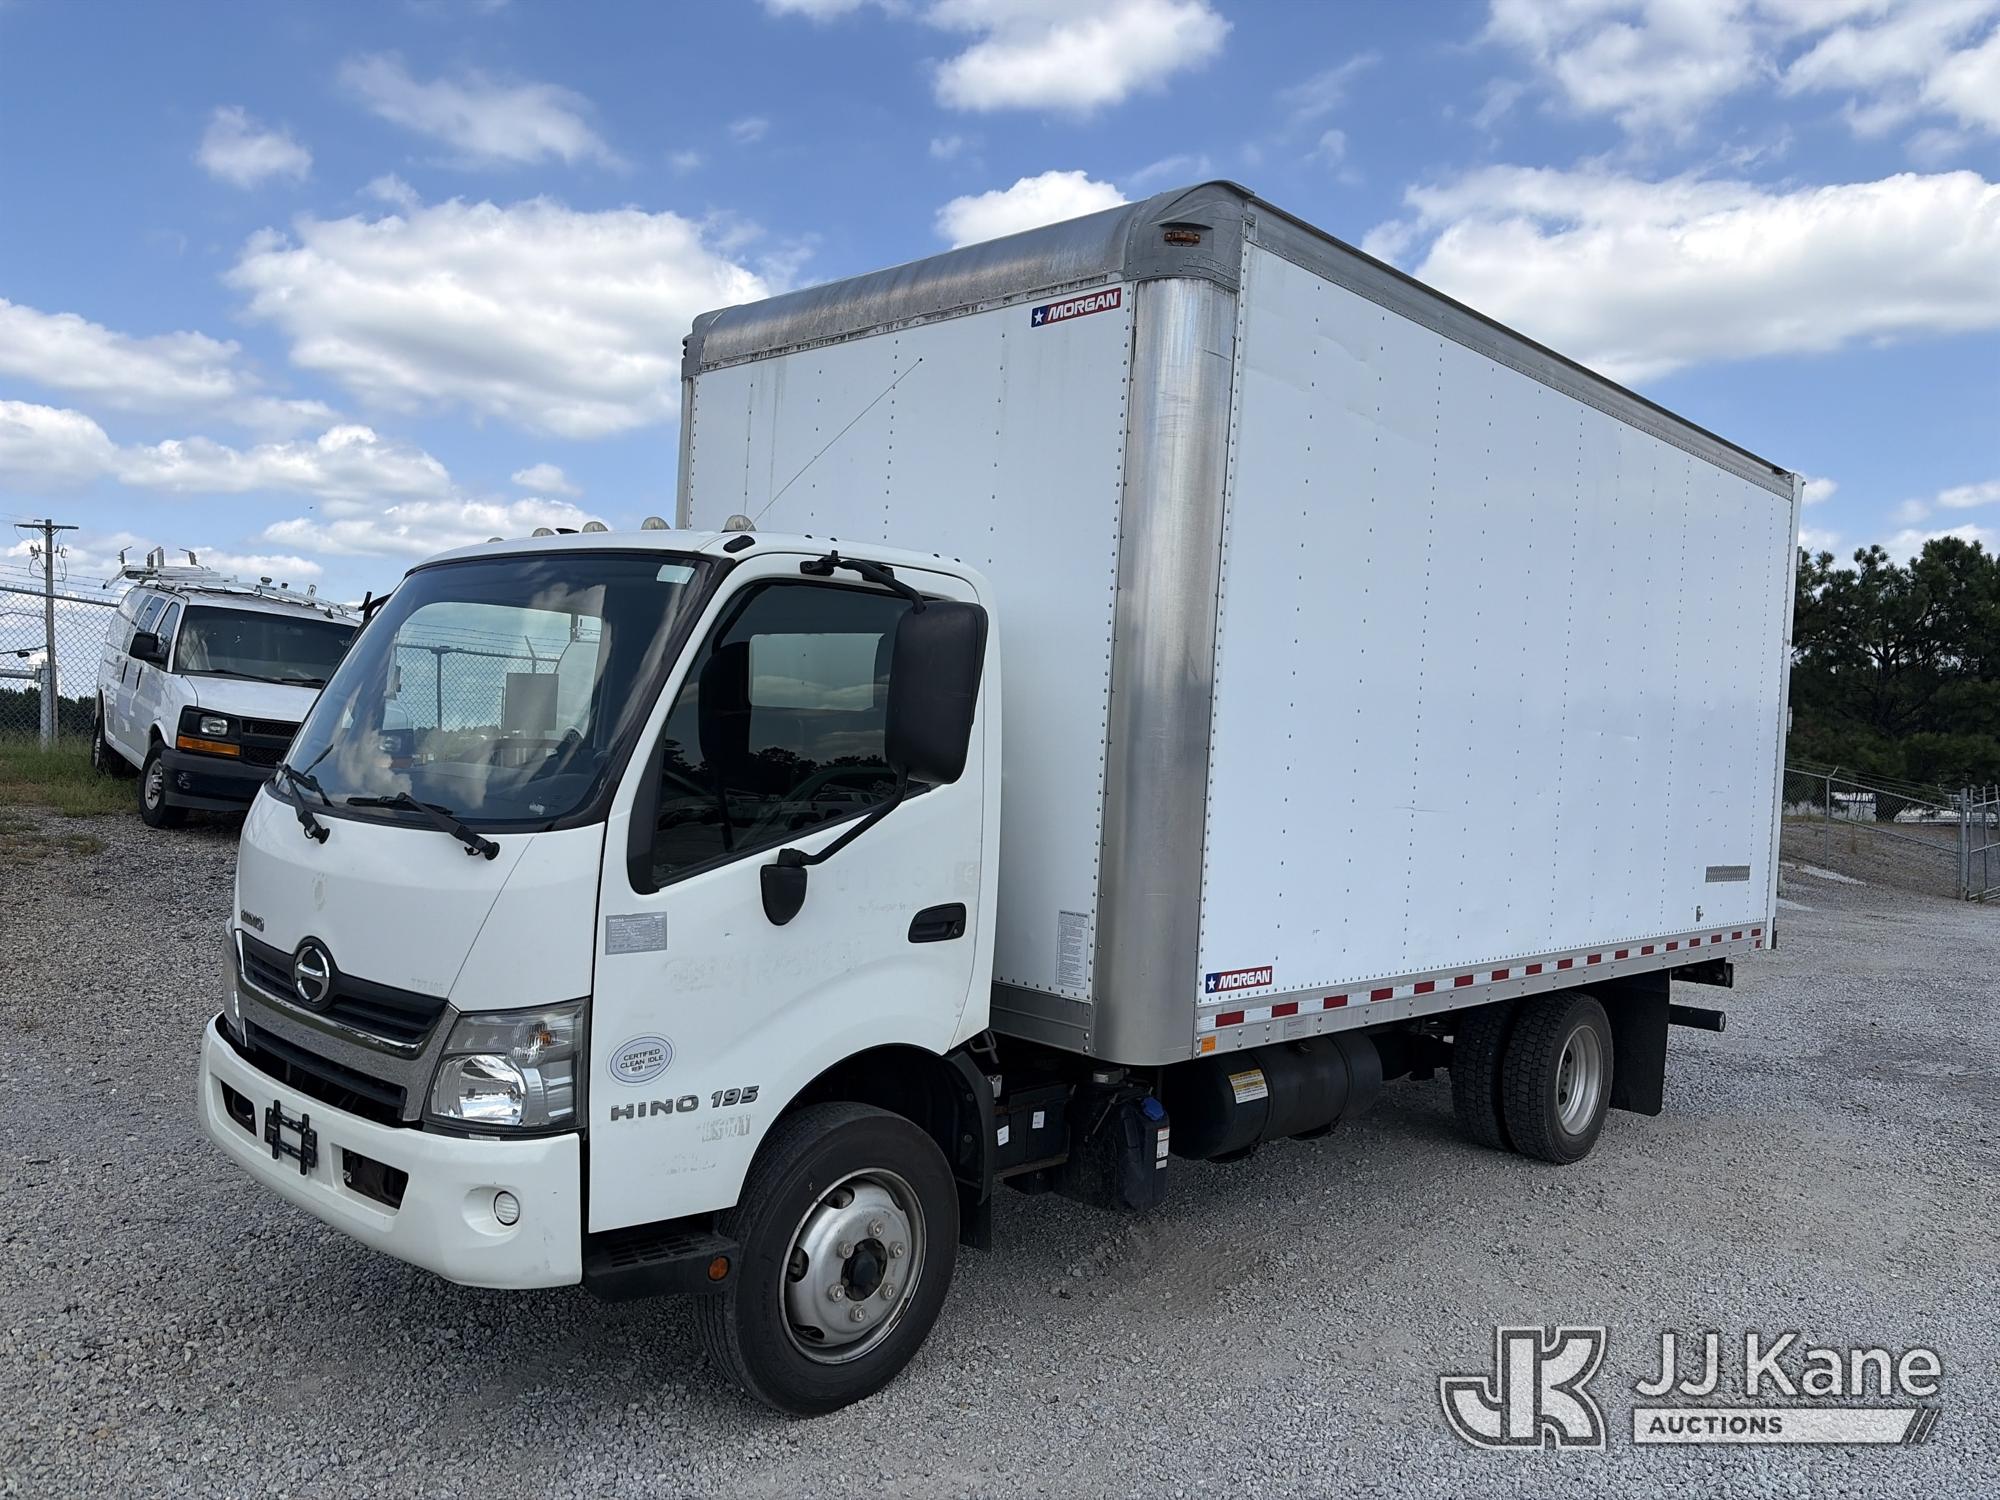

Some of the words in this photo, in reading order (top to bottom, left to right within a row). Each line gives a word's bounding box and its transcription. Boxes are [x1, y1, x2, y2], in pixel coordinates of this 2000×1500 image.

[1048, 291, 1118, 321] MORGAN
[1218, 969, 1271, 989] MORGAN
[620, 1059, 645, 1069] CLEAN
[647, 1054, 664, 1063] IDLE
[623, 1048, 661, 1061] CERTIFIED
[610, 1095, 699, 1121] HINO
[711, 1085, 760, 1109] 195
